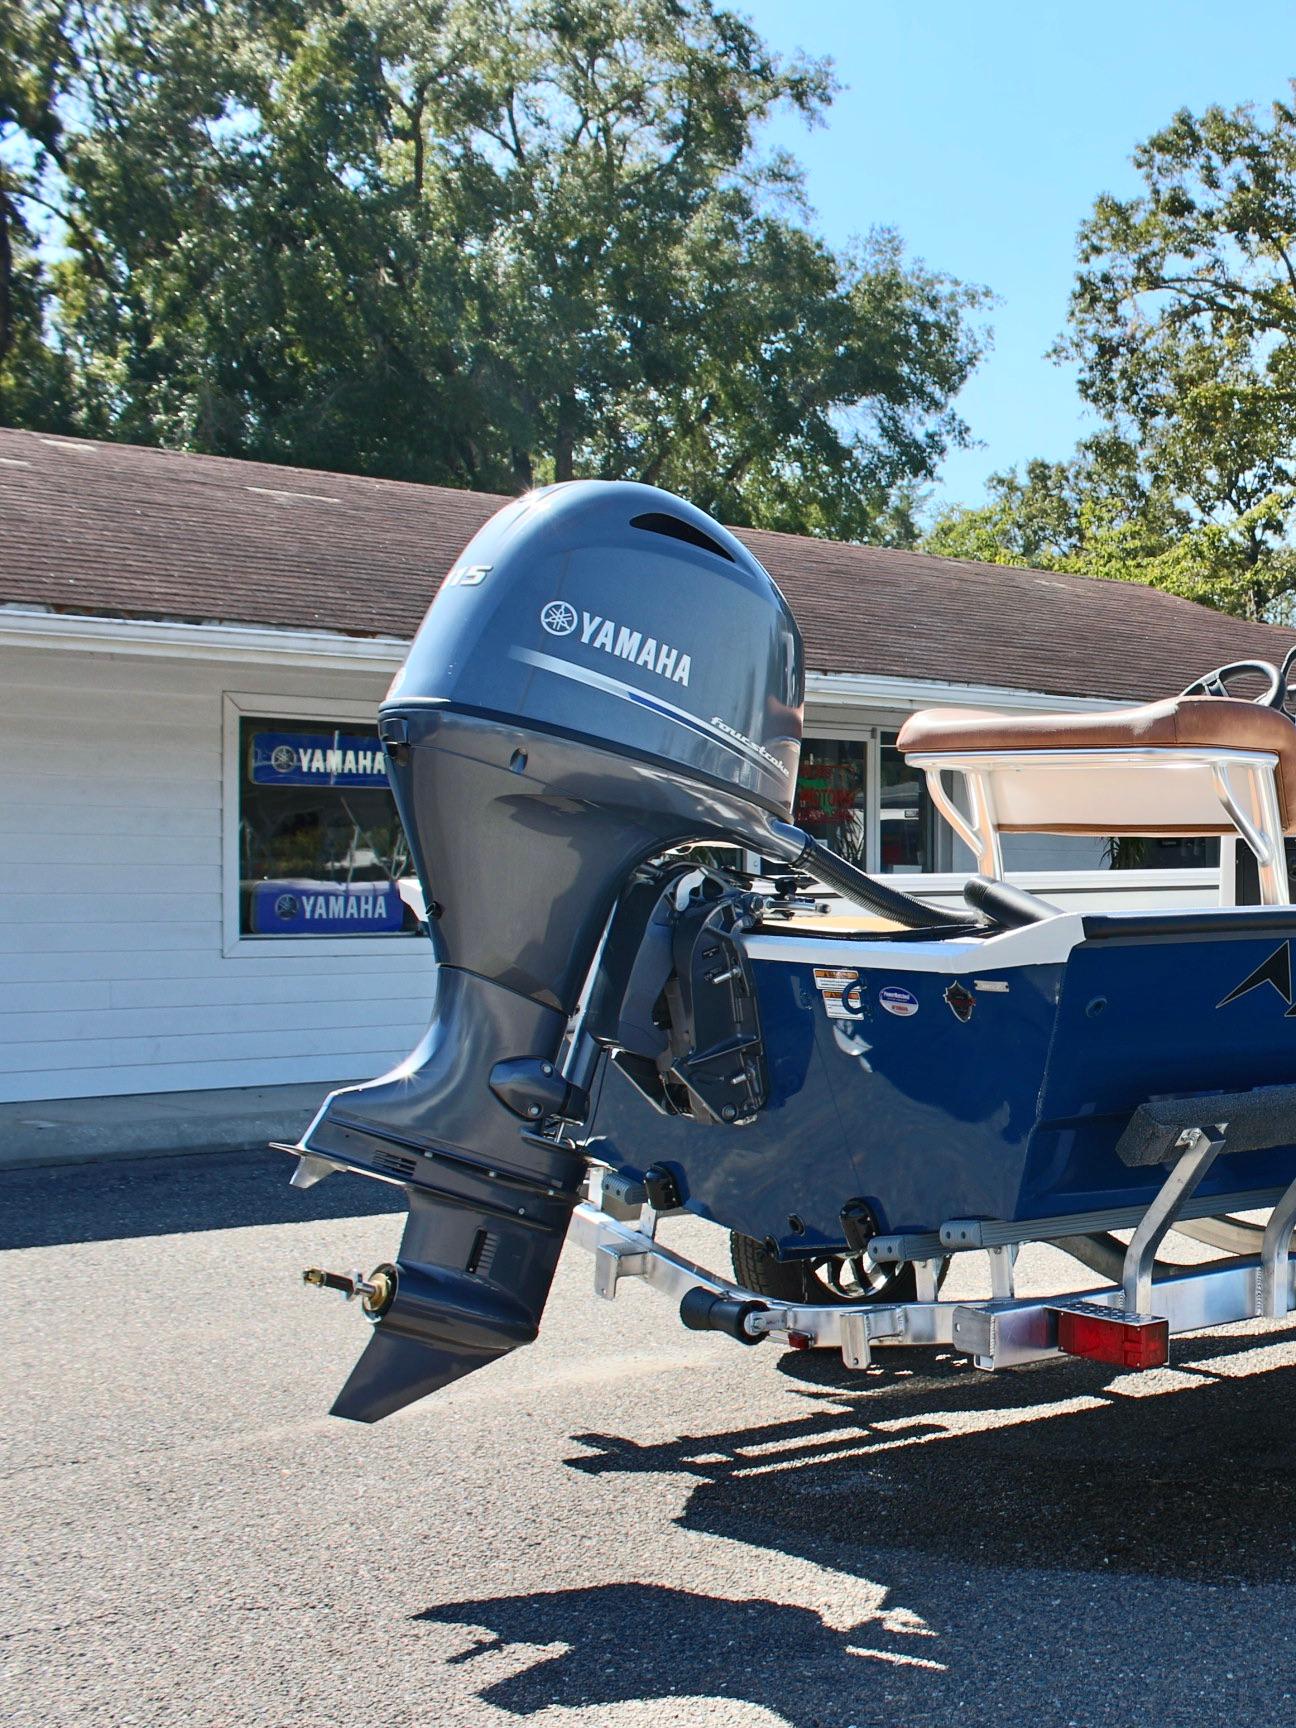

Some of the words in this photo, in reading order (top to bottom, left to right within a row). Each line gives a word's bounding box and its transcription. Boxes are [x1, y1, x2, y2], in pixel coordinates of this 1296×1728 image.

[581, 611, 691, 687] YAMAHA
[299, 748, 386, 775] YAMAHA
[302, 896, 387, 919] YAMAHA
